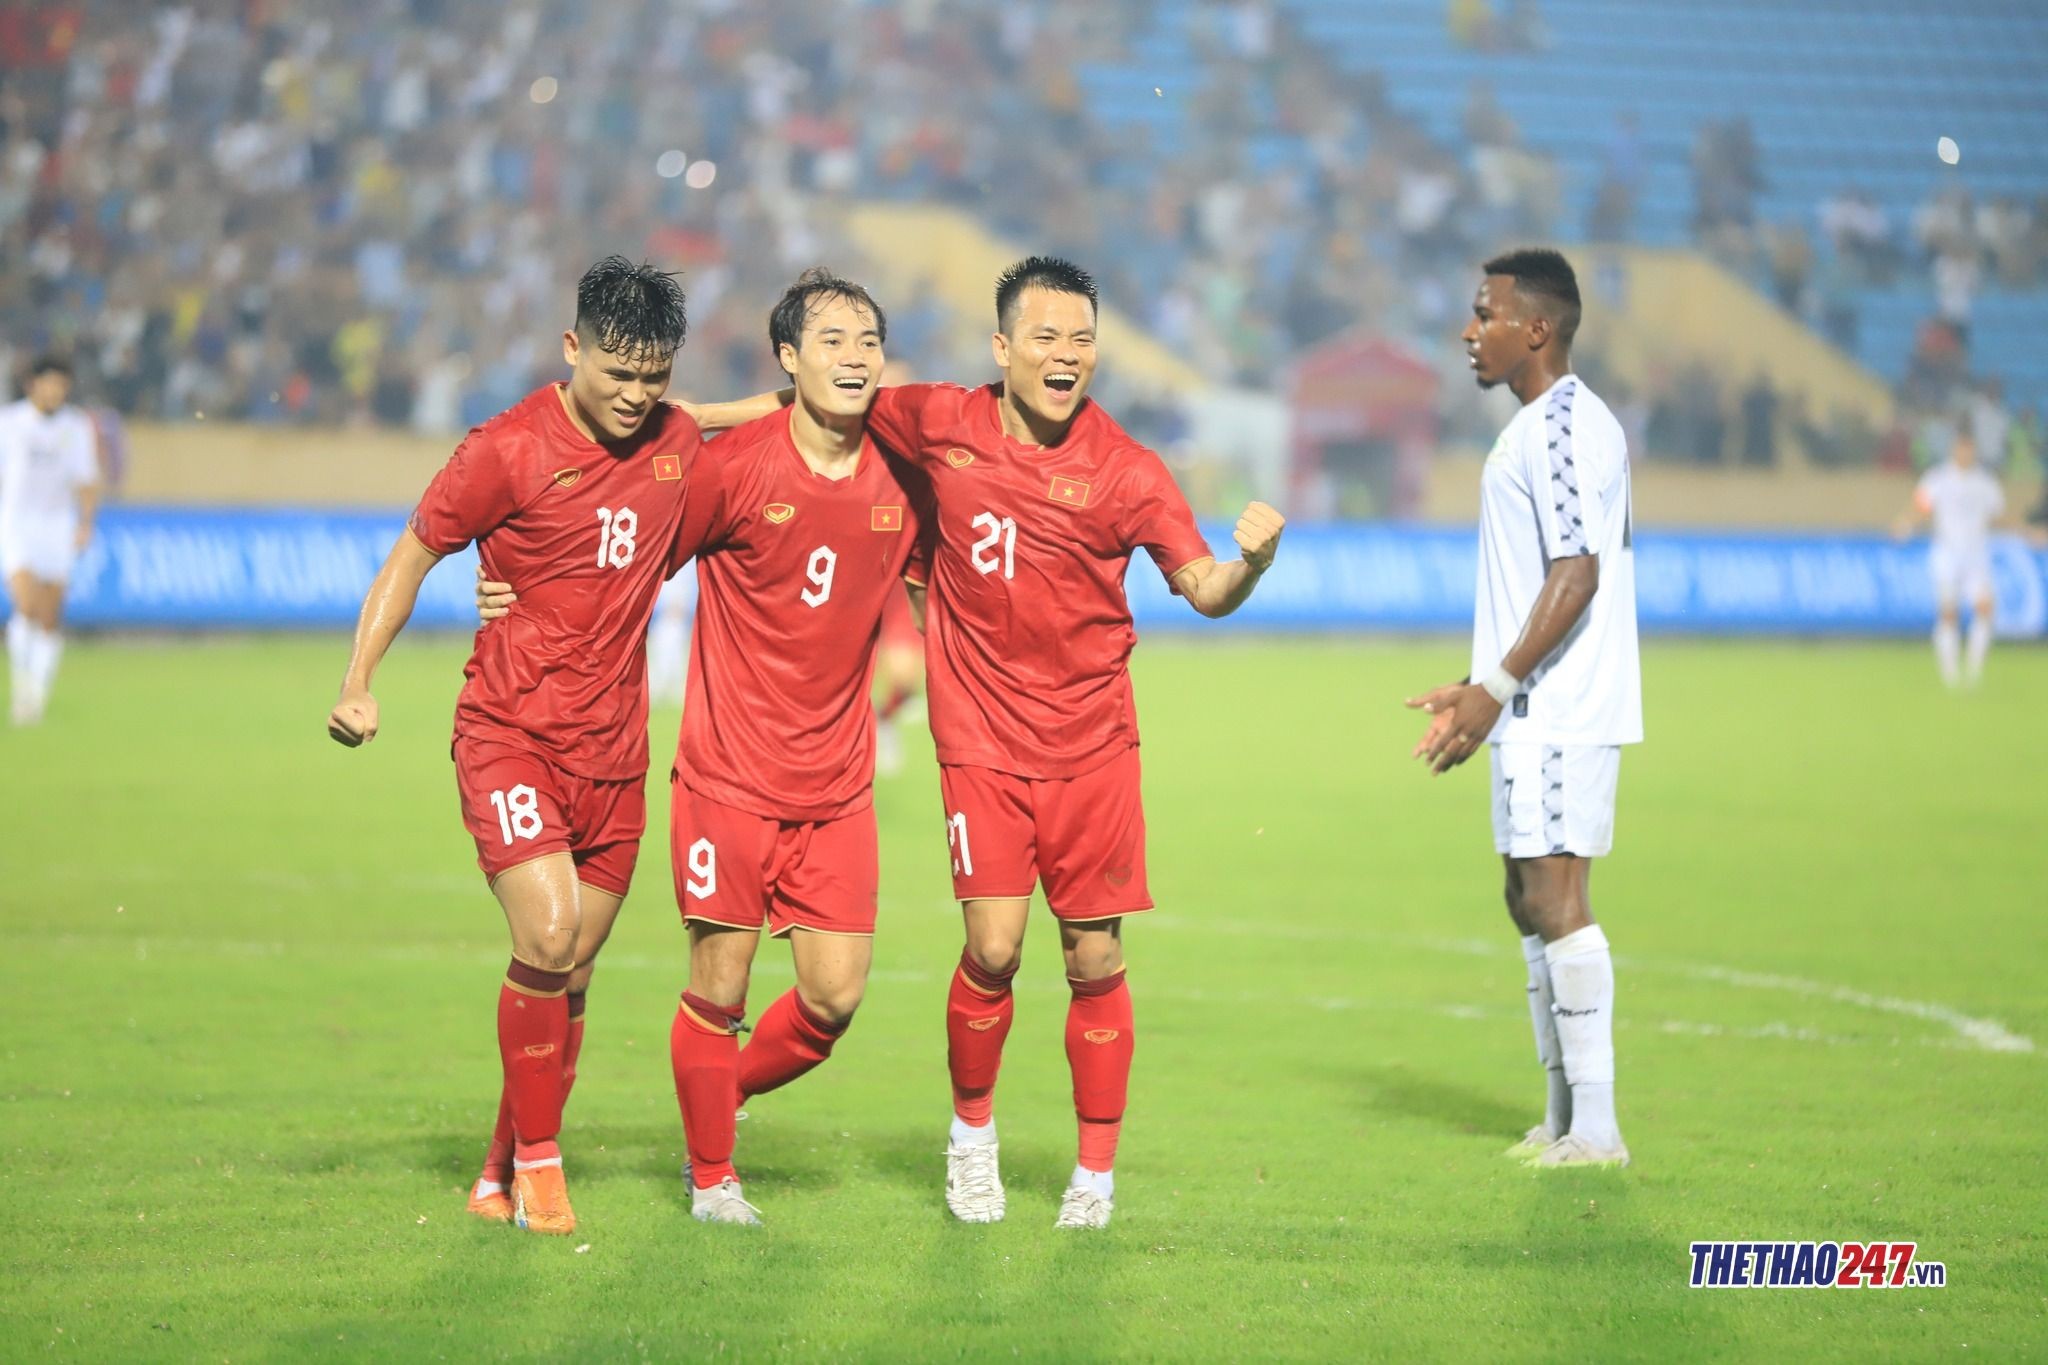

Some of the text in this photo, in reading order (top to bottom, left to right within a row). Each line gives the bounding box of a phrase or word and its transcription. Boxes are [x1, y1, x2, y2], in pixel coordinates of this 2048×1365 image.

[596, 506, 637, 569] 18
[971, 511, 1017, 580] 21
[800, 545, 837, 608] 9
[489, 783, 544, 846] 18
[686, 837, 716, 900] 9
